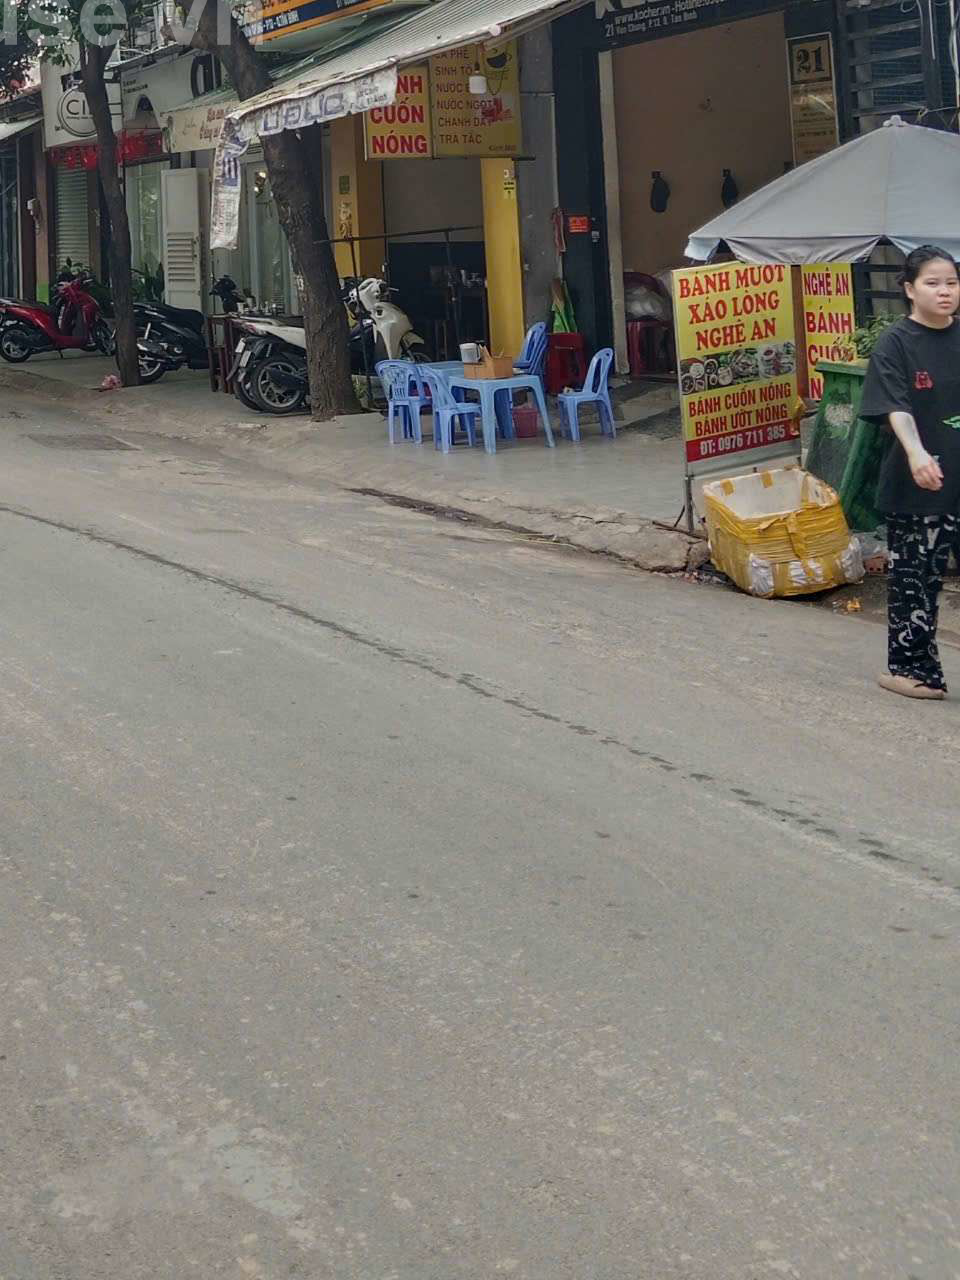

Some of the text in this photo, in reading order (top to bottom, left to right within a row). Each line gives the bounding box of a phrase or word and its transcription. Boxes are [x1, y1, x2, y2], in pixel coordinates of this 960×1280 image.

[435, 66, 456, 76] SINH
[797, 47, 825, 73] 21
[397, 75, 422, 94] NH
[369, 97, 424, 123] CUỐN
[372, 130, 428, 154] NÓNG
[679, 271, 730, 298] BÁNH
[835, 272, 849, 296] AN
[689, 290, 780, 324] XÁO LÒNG
[806, 306, 852, 333] BÁNH
[696, 317, 776, 350] NGHỆ AN
[689, 396, 721, 417] BÁNH
[724, 385, 756, 410] CUỐN
[759, 382, 791, 402] NÓNG
[695, 416, 727, 437] BÁNH
[756, 403, 788, 424] NÓNG
[700, 439, 715, 455] ĐT:
[718, 434, 743, 451] 0976
[745, 429, 764, 444] 711
